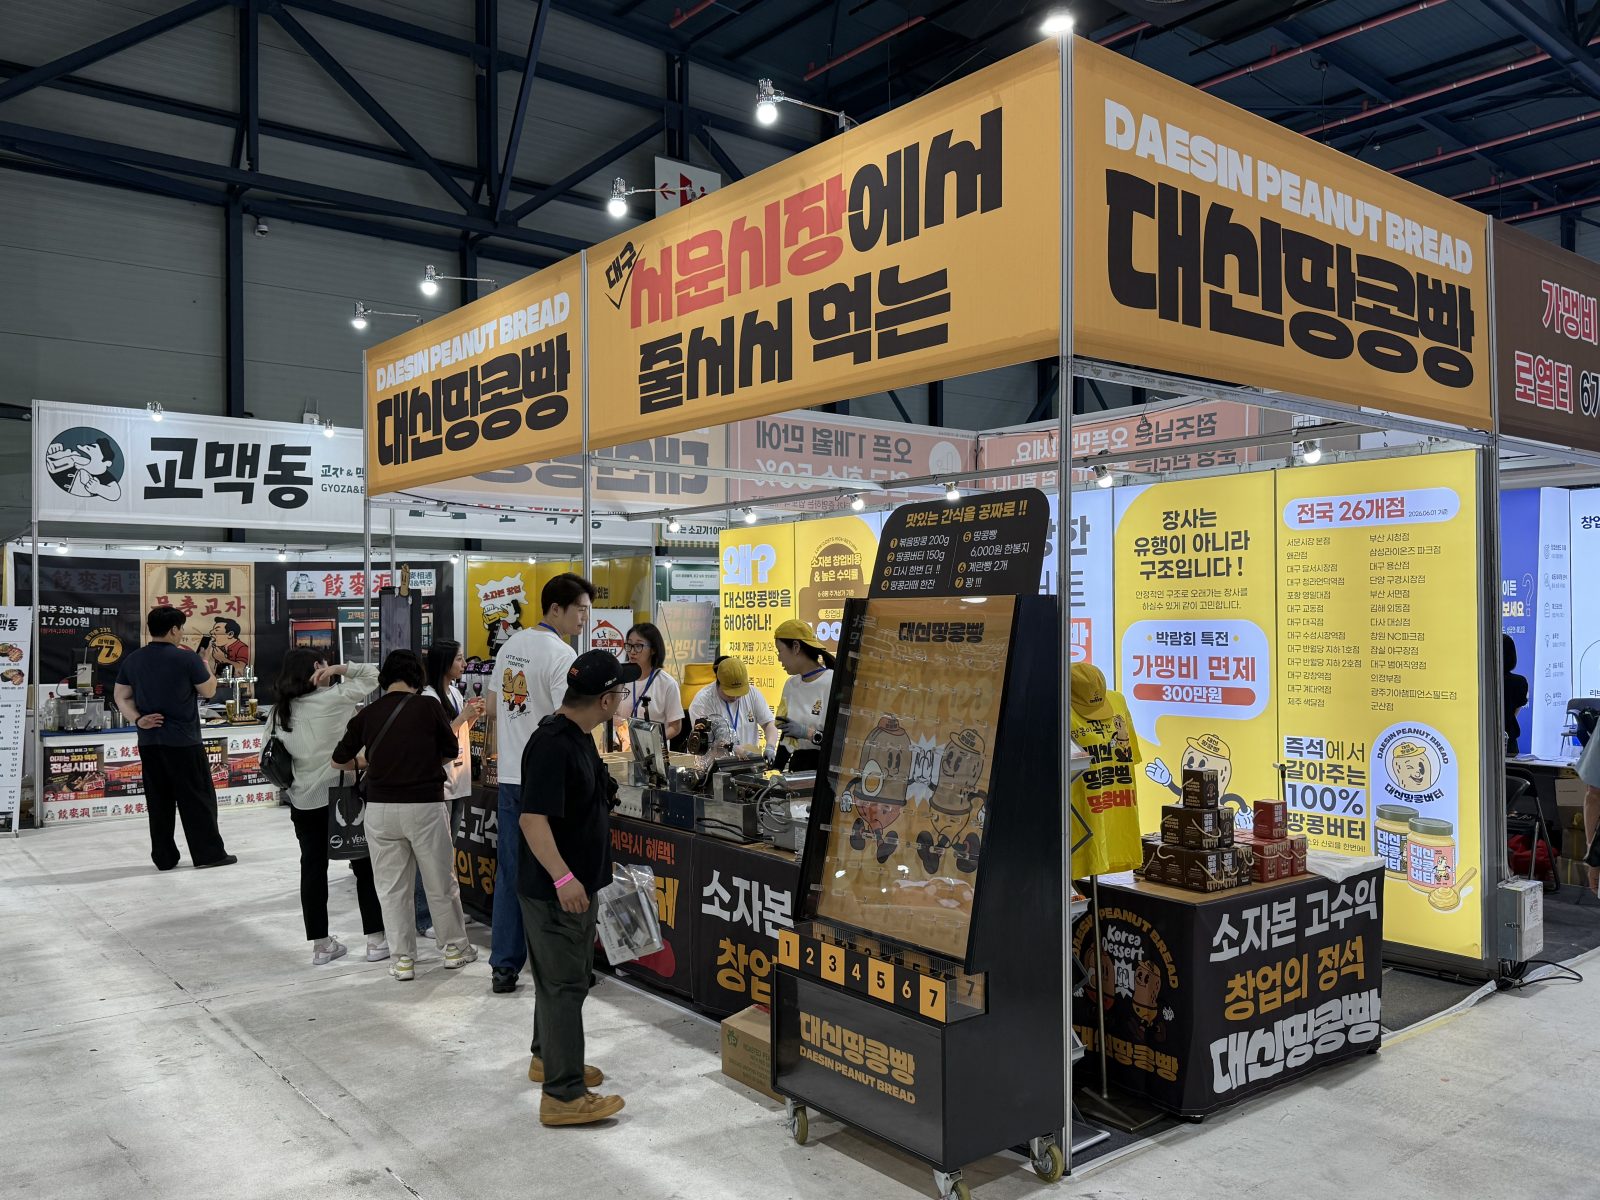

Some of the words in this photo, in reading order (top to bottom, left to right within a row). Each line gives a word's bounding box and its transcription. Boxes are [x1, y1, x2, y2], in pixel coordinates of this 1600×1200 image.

[1104, 98, 1253, 198] DAESIN
[1257, 161, 1382, 243] PEANUT
[1386, 211, 1474, 275] BREAD
[630, 106, 1003, 329] 서문시장에서
[605, 241, 637, 289] 대구
[1105, 168, 1475, 389] 대신땅콩빵
[1541, 279, 1598, 346] 가맹비
[377, 349, 429, 392] DAESIN
[431, 320, 498, 372] PEANUT
[500, 292, 570, 345] BREAD
[638, 297, 793, 415] 줄서서
[809, 265, 951, 365] 먹는
[1515, 350, 1573, 414] 로열티
[377, 332, 571, 466] 대신땅콩빵
[144, 437, 314, 509] 교맥동
[320, 464, 343, 478] 교자
[905, 510, 939, 528] 맛있는
[940, 505, 976, 525] 간식을
[978, 500, 1015, 521] 공짜로
[1162, 507, 1217, 531] 장사는
[1297, 501, 1334, 524] 전국
[1338, 496, 1405, 521] 26개점
[928, 534, 950, 547] 200g
[970, 544, 1002, 557] 6,000원
[1004, 542, 1030, 555] 한봉지
[1133, 534, 1185, 557] 유행이
[1192, 530, 1250, 553] 아니라
[722, 543, 777, 587] 왜?
[892, 565, 908, 576] 다시
[908, 564, 924, 576] 한번
[896, 551, 925, 563] 땅콩버터
[926, 550, 946, 562] 150g
[993, 559, 1009, 571] 2개
[1139, 556, 1232, 580] 구조입니다
[723, 589, 792, 609] 대신땅콩빵을
[1135, 590, 1165, 599] 안정적인
[1165, 589, 1189, 599] 구조로
[1190, 588, 1223, 599] 오래가는
[1223, 587, 1248, 598] 장사를
[723, 613, 772, 632] 해야하나!
[899, 621, 985, 643] 대신땅콩빵
[1155, 631, 1196, 646] 박람회
[1200, 631, 1229, 647] 특전
[1132, 655, 1198, 680] 가맹비
[1207, 656, 1256, 682] 면제
[1162, 684, 1223, 704] 300만원
[1285, 737, 1365, 763] 즉석에서
[1377, 732, 1397, 760] DAESIN
[1396, 727, 1431, 739] PEANUT
[1430, 735, 1449, 765] BREAD
[1286, 759, 1366, 786] 갈아주는
[1287, 783, 1364, 815] 100%
[1384, 782, 1445, 804] 대신땅콩버터
[1286, 812, 1366, 841] 땅콩버터
[646, 838, 675, 865] 혜택!
[702, 869, 794, 940] 소자본
[1209, 896, 1297, 963] 소자본
[1304, 876, 1378, 938] 고수익
[1099, 907, 1152, 932] PEANUT
[1150, 929, 1179, 990] BREAD
[1102, 936, 1145, 963] Dessert
[1107, 924, 1142, 947] Korea
[785, 940, 791, 957] 1
[806, 947, 815, 966] 2
[828, 955, 837, 972] 3
[851, 963, 862, 981] 4
[876, 972, 885, 989] 5
[902, 980, 912, 999] 6
[928, 988, 938, 1008] 7
[1223, 952, 1309, 1021] 창업의
[1317, 935, 1365, 991] 정석
[800, 1011, 916, 1086] 대신땅콩빵
[1209, 989, 1382, 1094] 대신땅콩빵
[800, 1045, 835, 1070] DAESIN
[835, 1062, 876, 1088] PEANUT
[876, 1079, 916, 1104] BREAD
